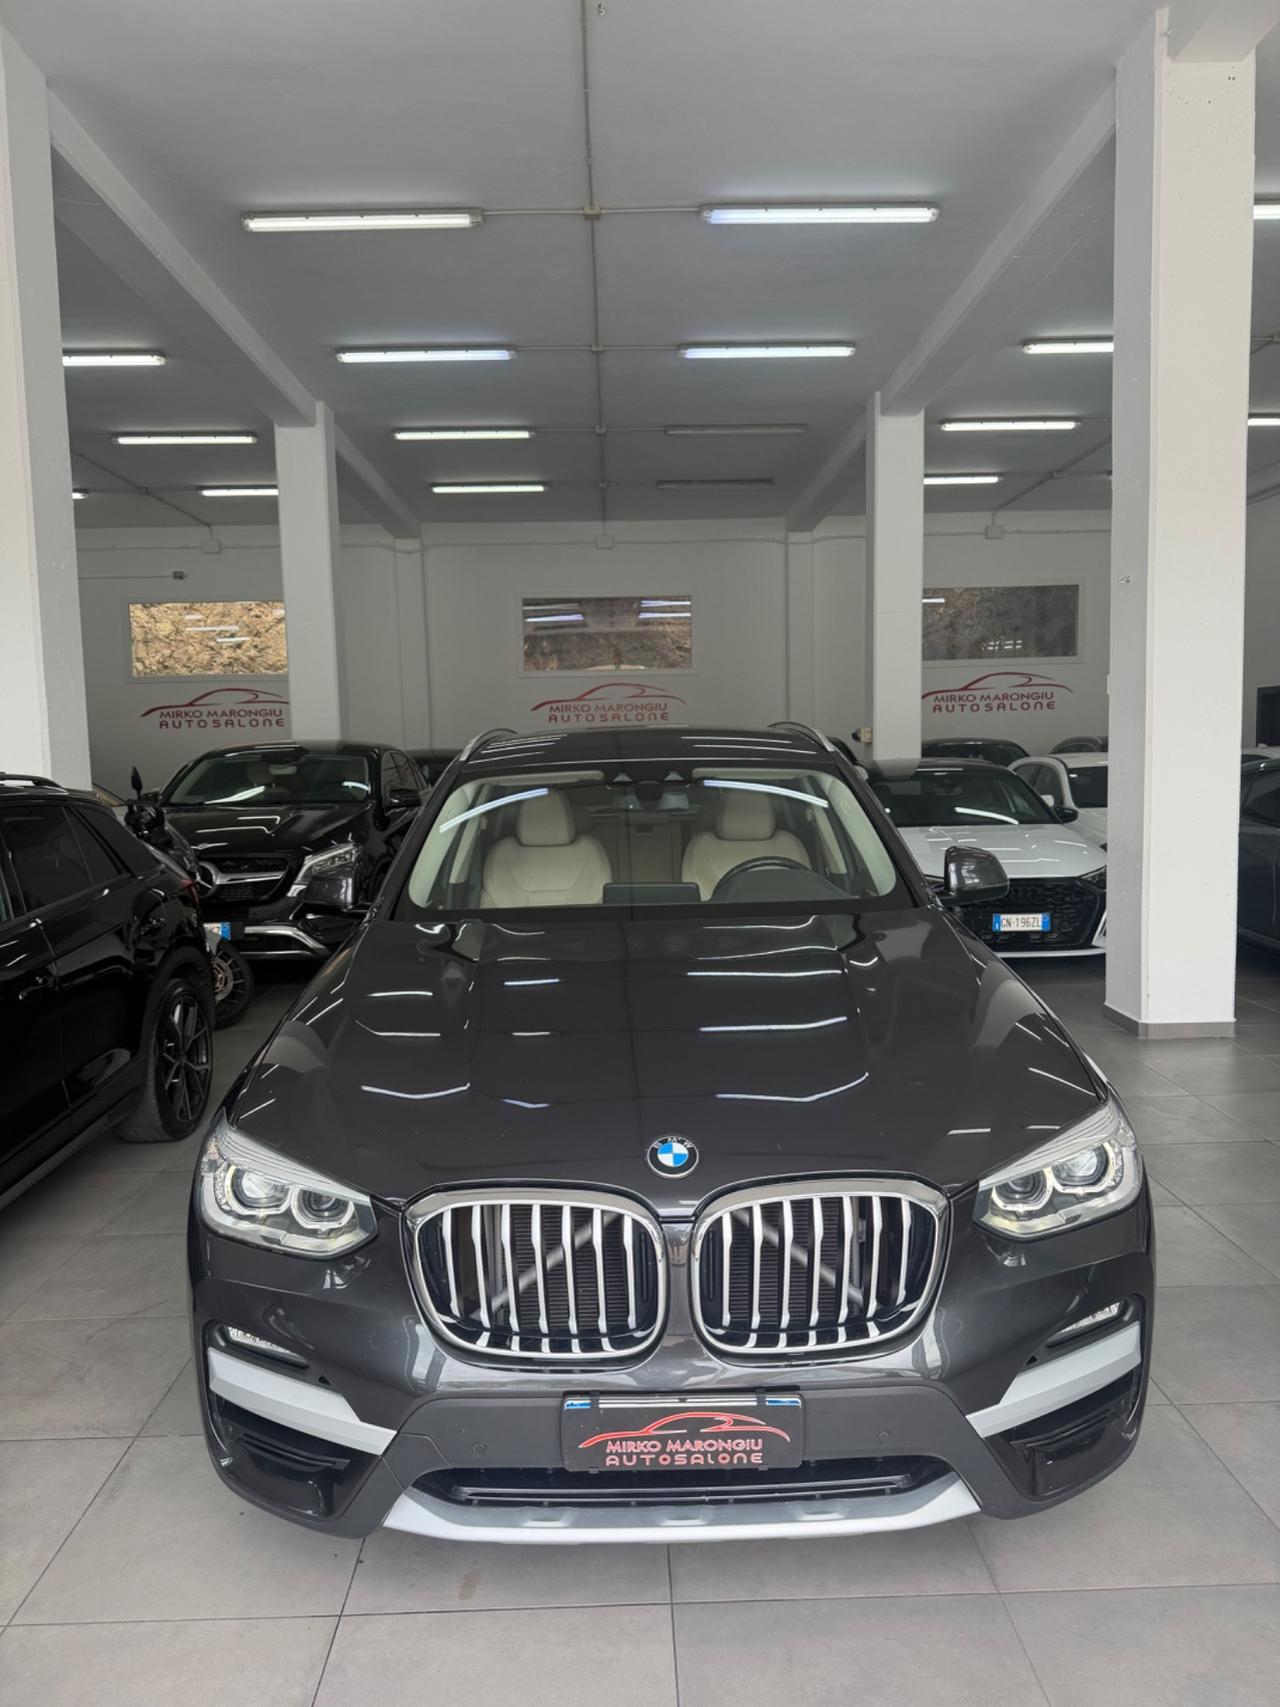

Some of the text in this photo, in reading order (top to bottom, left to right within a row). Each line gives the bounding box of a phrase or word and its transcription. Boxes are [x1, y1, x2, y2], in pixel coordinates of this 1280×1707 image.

[934, 691, 1054, 704] MIRKO MARONGIU
[159, 708, 283, 719] MIRKO MARONGIU
[549, 702, 668, 713] MIRKO MARONGIU
[605, 1438, 763, 1453] MIRKO MARONGIU
